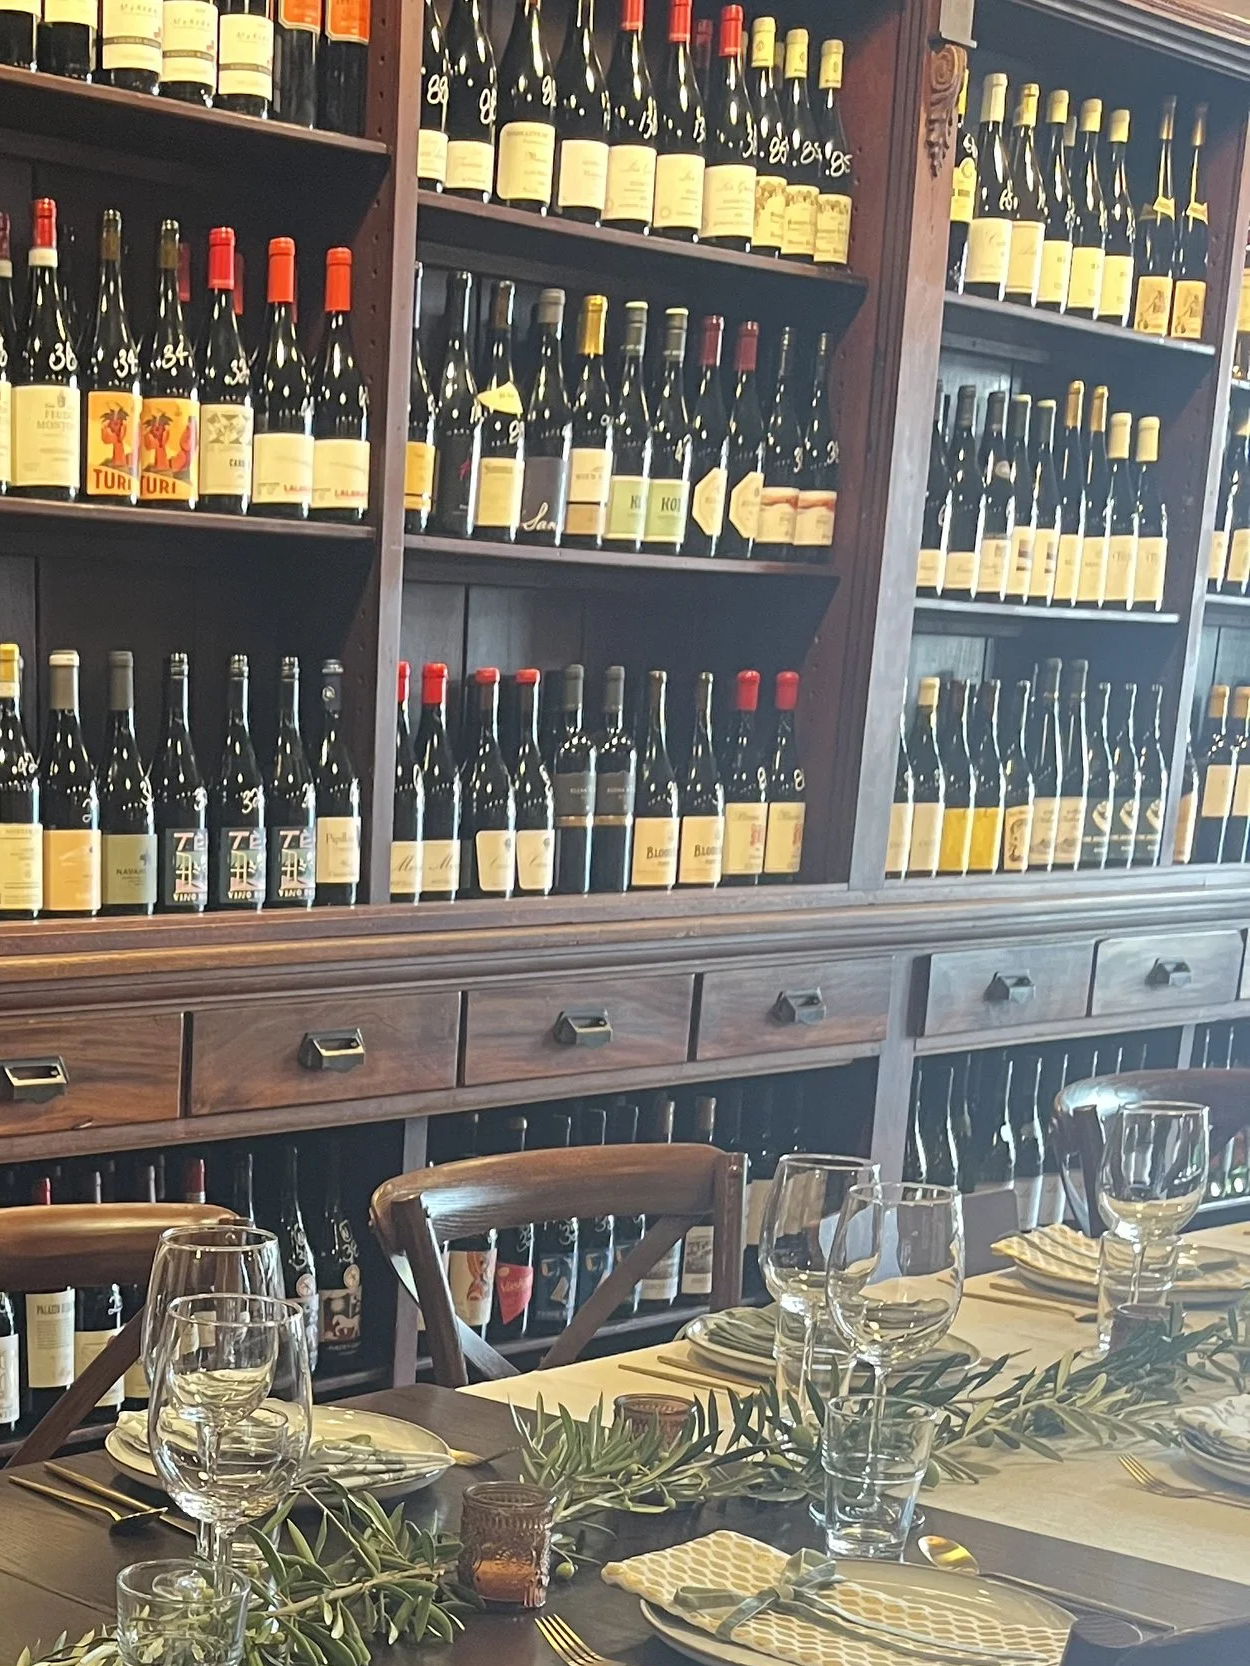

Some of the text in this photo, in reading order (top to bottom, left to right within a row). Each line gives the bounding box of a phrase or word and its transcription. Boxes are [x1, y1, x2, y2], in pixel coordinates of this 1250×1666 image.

[49, 341, 79, 371] 36
[93, 468, 133, 491] TURI
[227, 890, 252, 900] VINO
[278, 888, 303, 898] VINO
